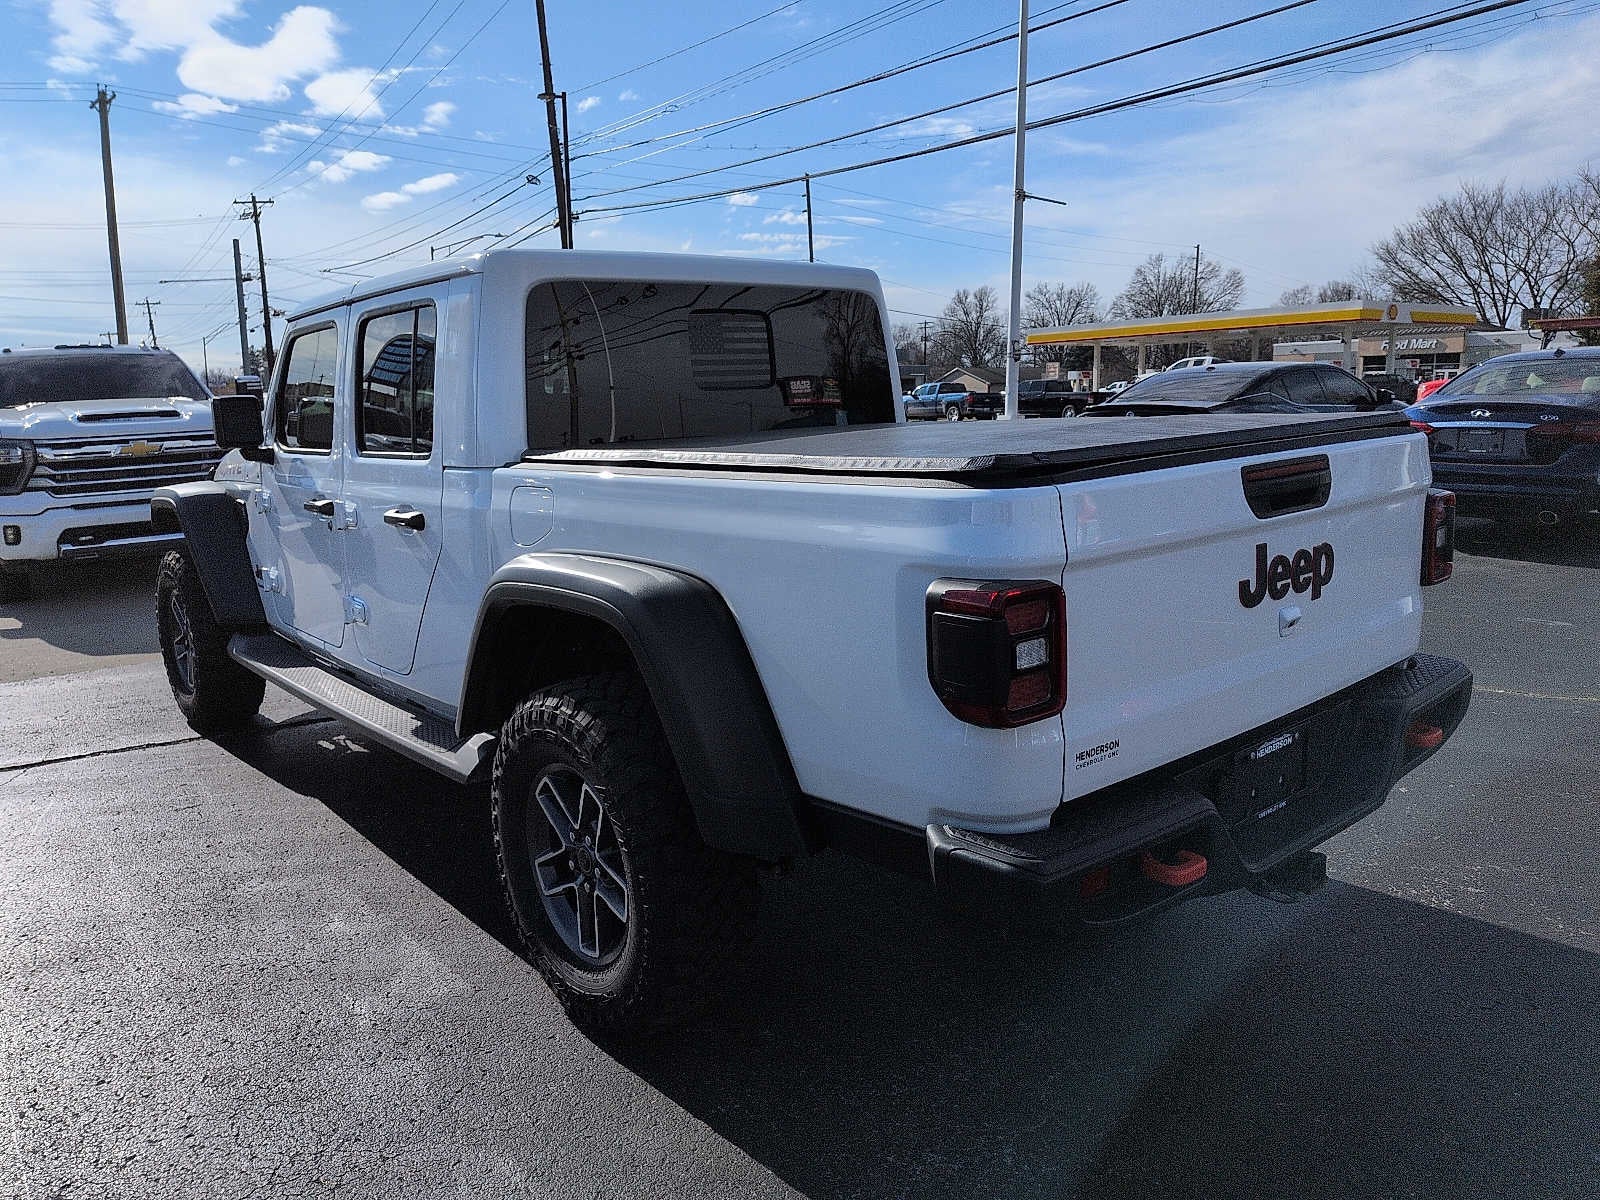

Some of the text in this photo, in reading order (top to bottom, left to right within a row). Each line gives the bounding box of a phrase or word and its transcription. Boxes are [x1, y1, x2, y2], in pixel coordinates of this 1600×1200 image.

[1381, 338, 1437, 351] Fod Mart
[1239, 542, 1334, 608] Jeep
[1075, 739, 1120, 762] HENDERSON
[1256, 735, 1293, 759] HENDERSON
